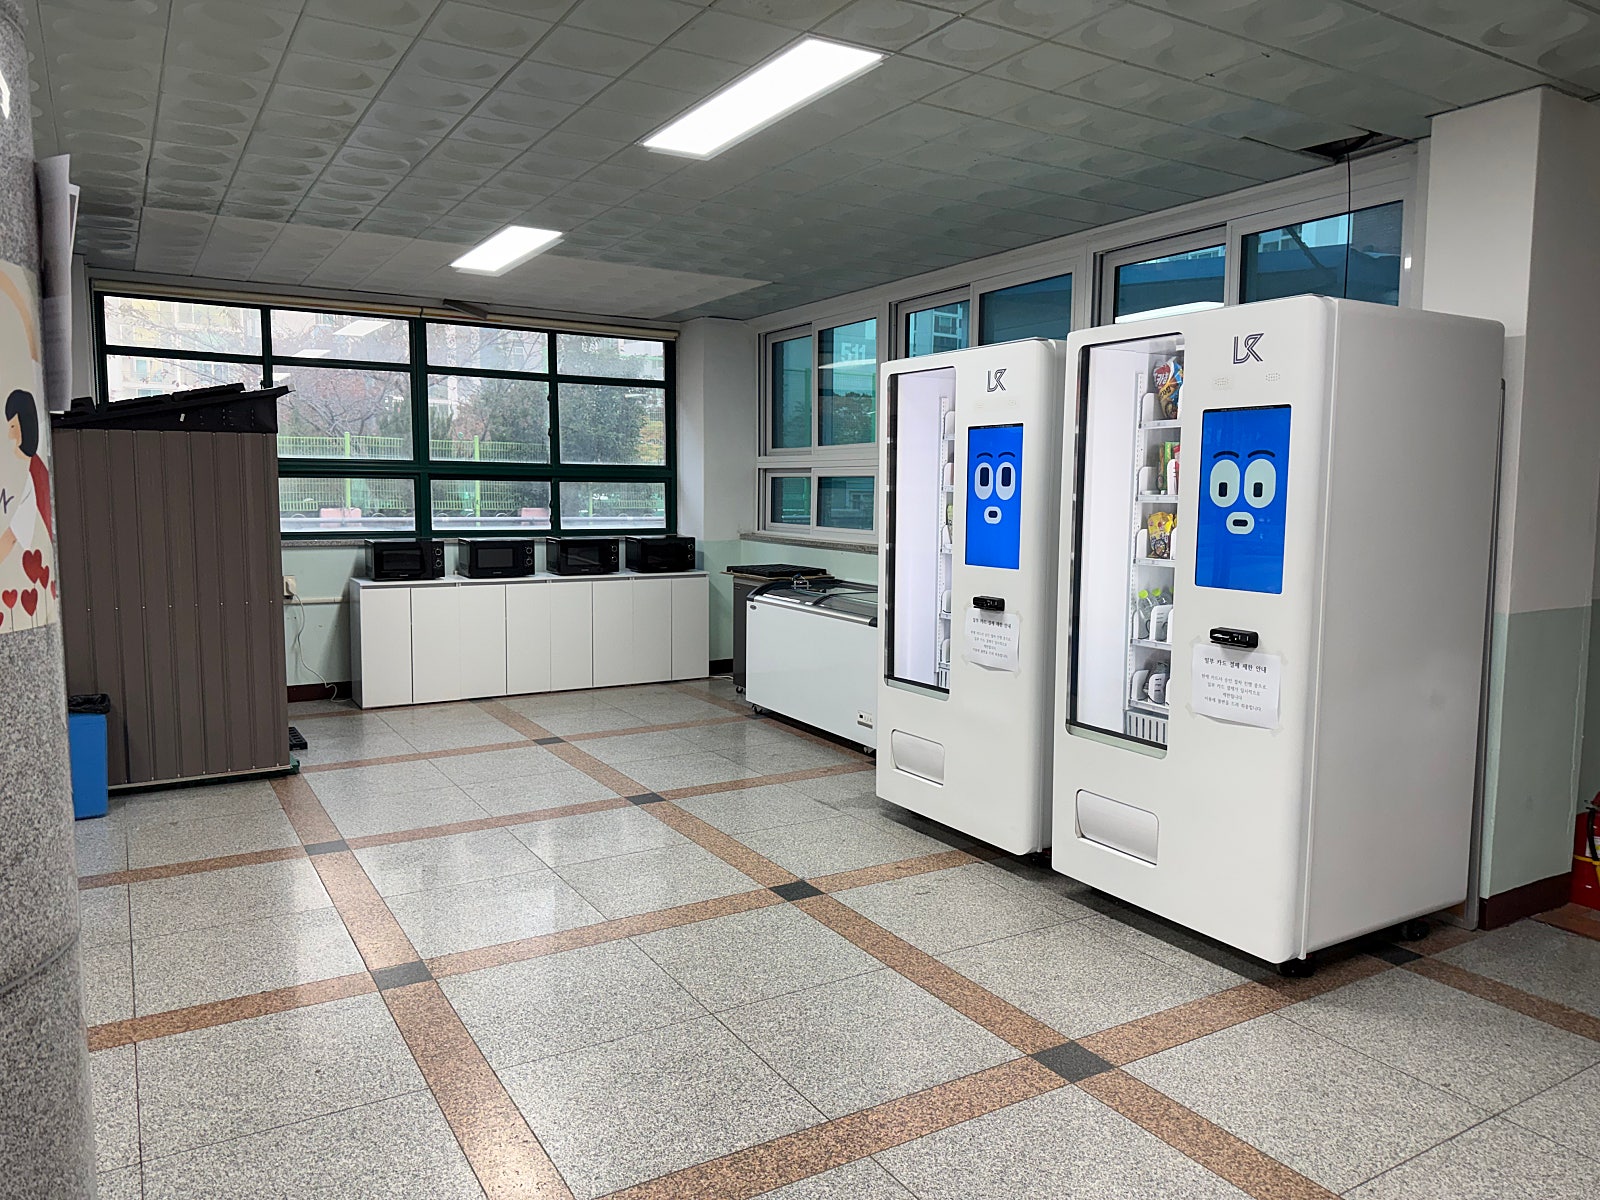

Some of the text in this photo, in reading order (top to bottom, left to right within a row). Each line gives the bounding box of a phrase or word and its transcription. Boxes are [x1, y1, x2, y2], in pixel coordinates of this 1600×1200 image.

[840, 342, 865, 361] 511
[1230, 661, 1240, 669] 결제
[1242, 663, 1253, 671] 제한
